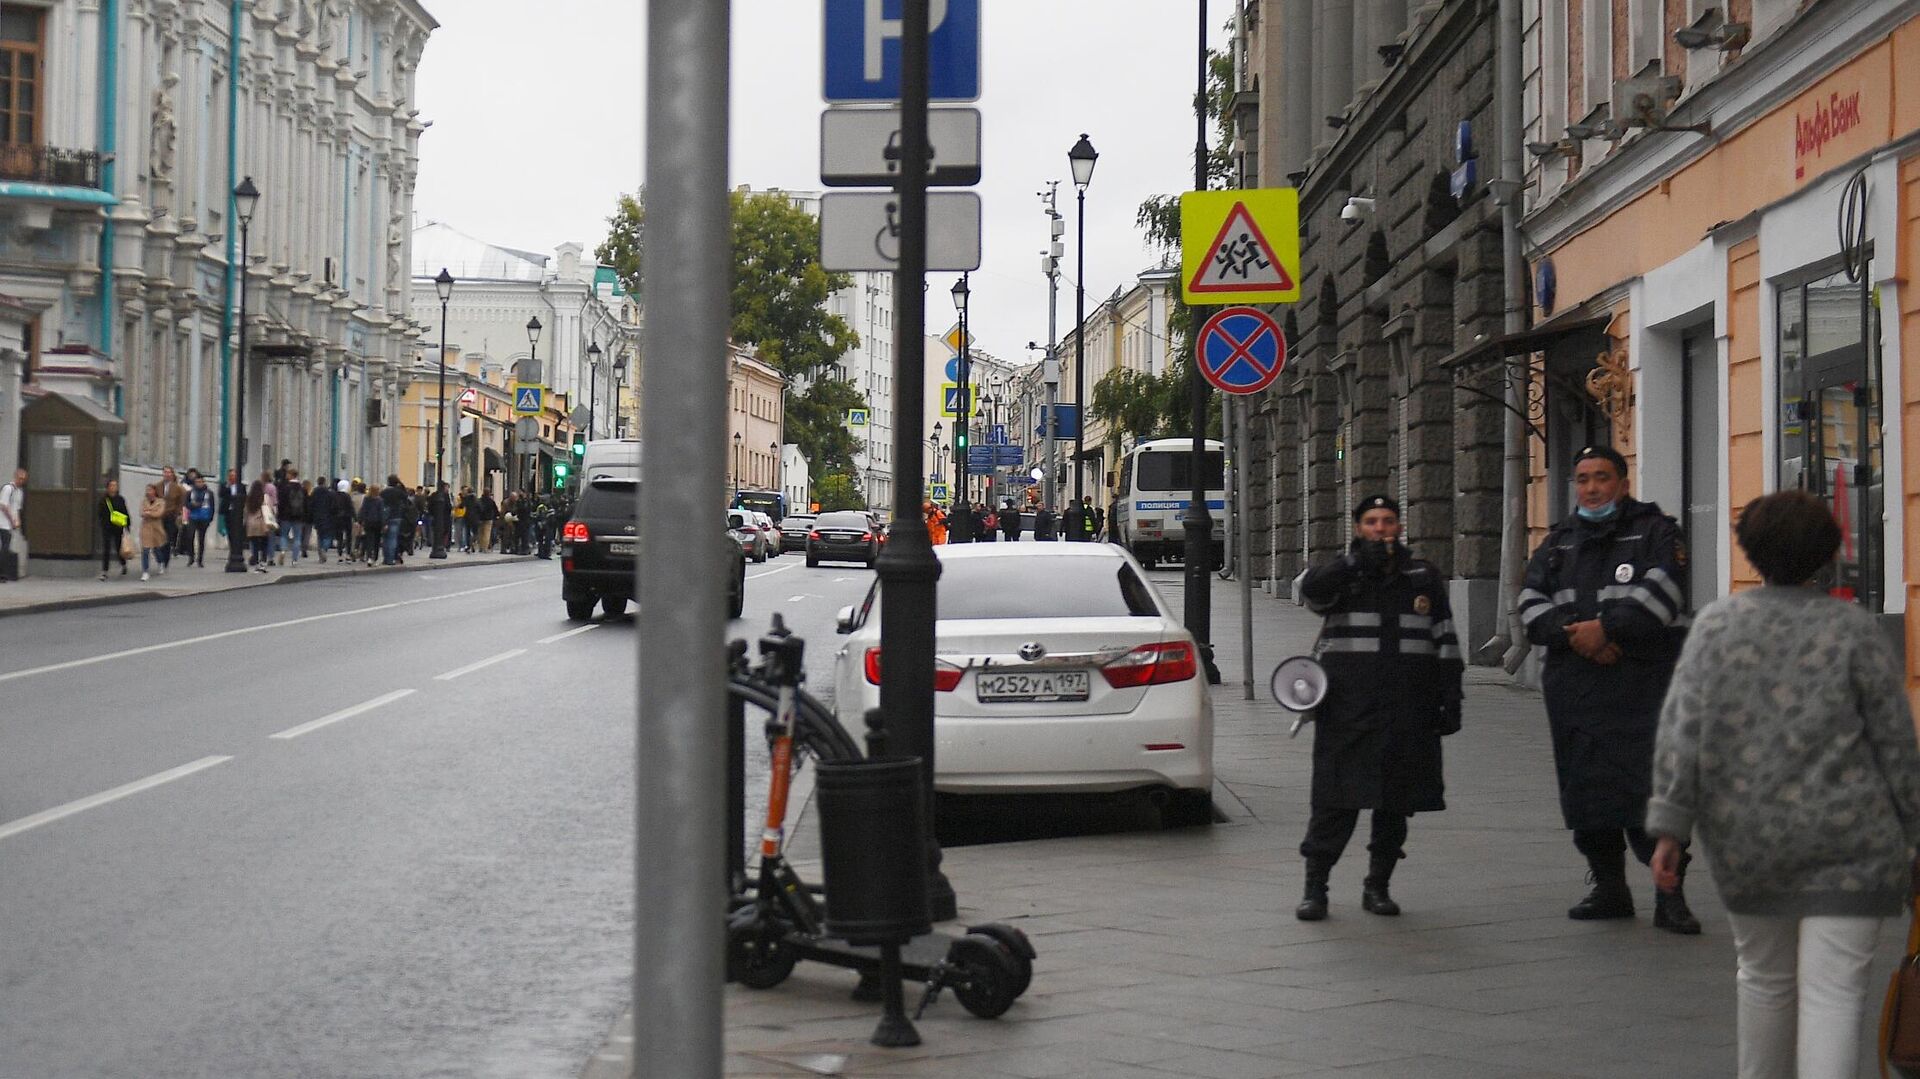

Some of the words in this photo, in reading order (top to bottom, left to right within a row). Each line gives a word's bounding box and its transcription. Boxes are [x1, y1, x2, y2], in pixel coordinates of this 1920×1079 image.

[1795, 100, 1830, 158] Альфа
[1830, 91, 1860, 138] Банк
[982, 676, 1053, 694] М252УА
[1056, 674, 1082, 687] 197
